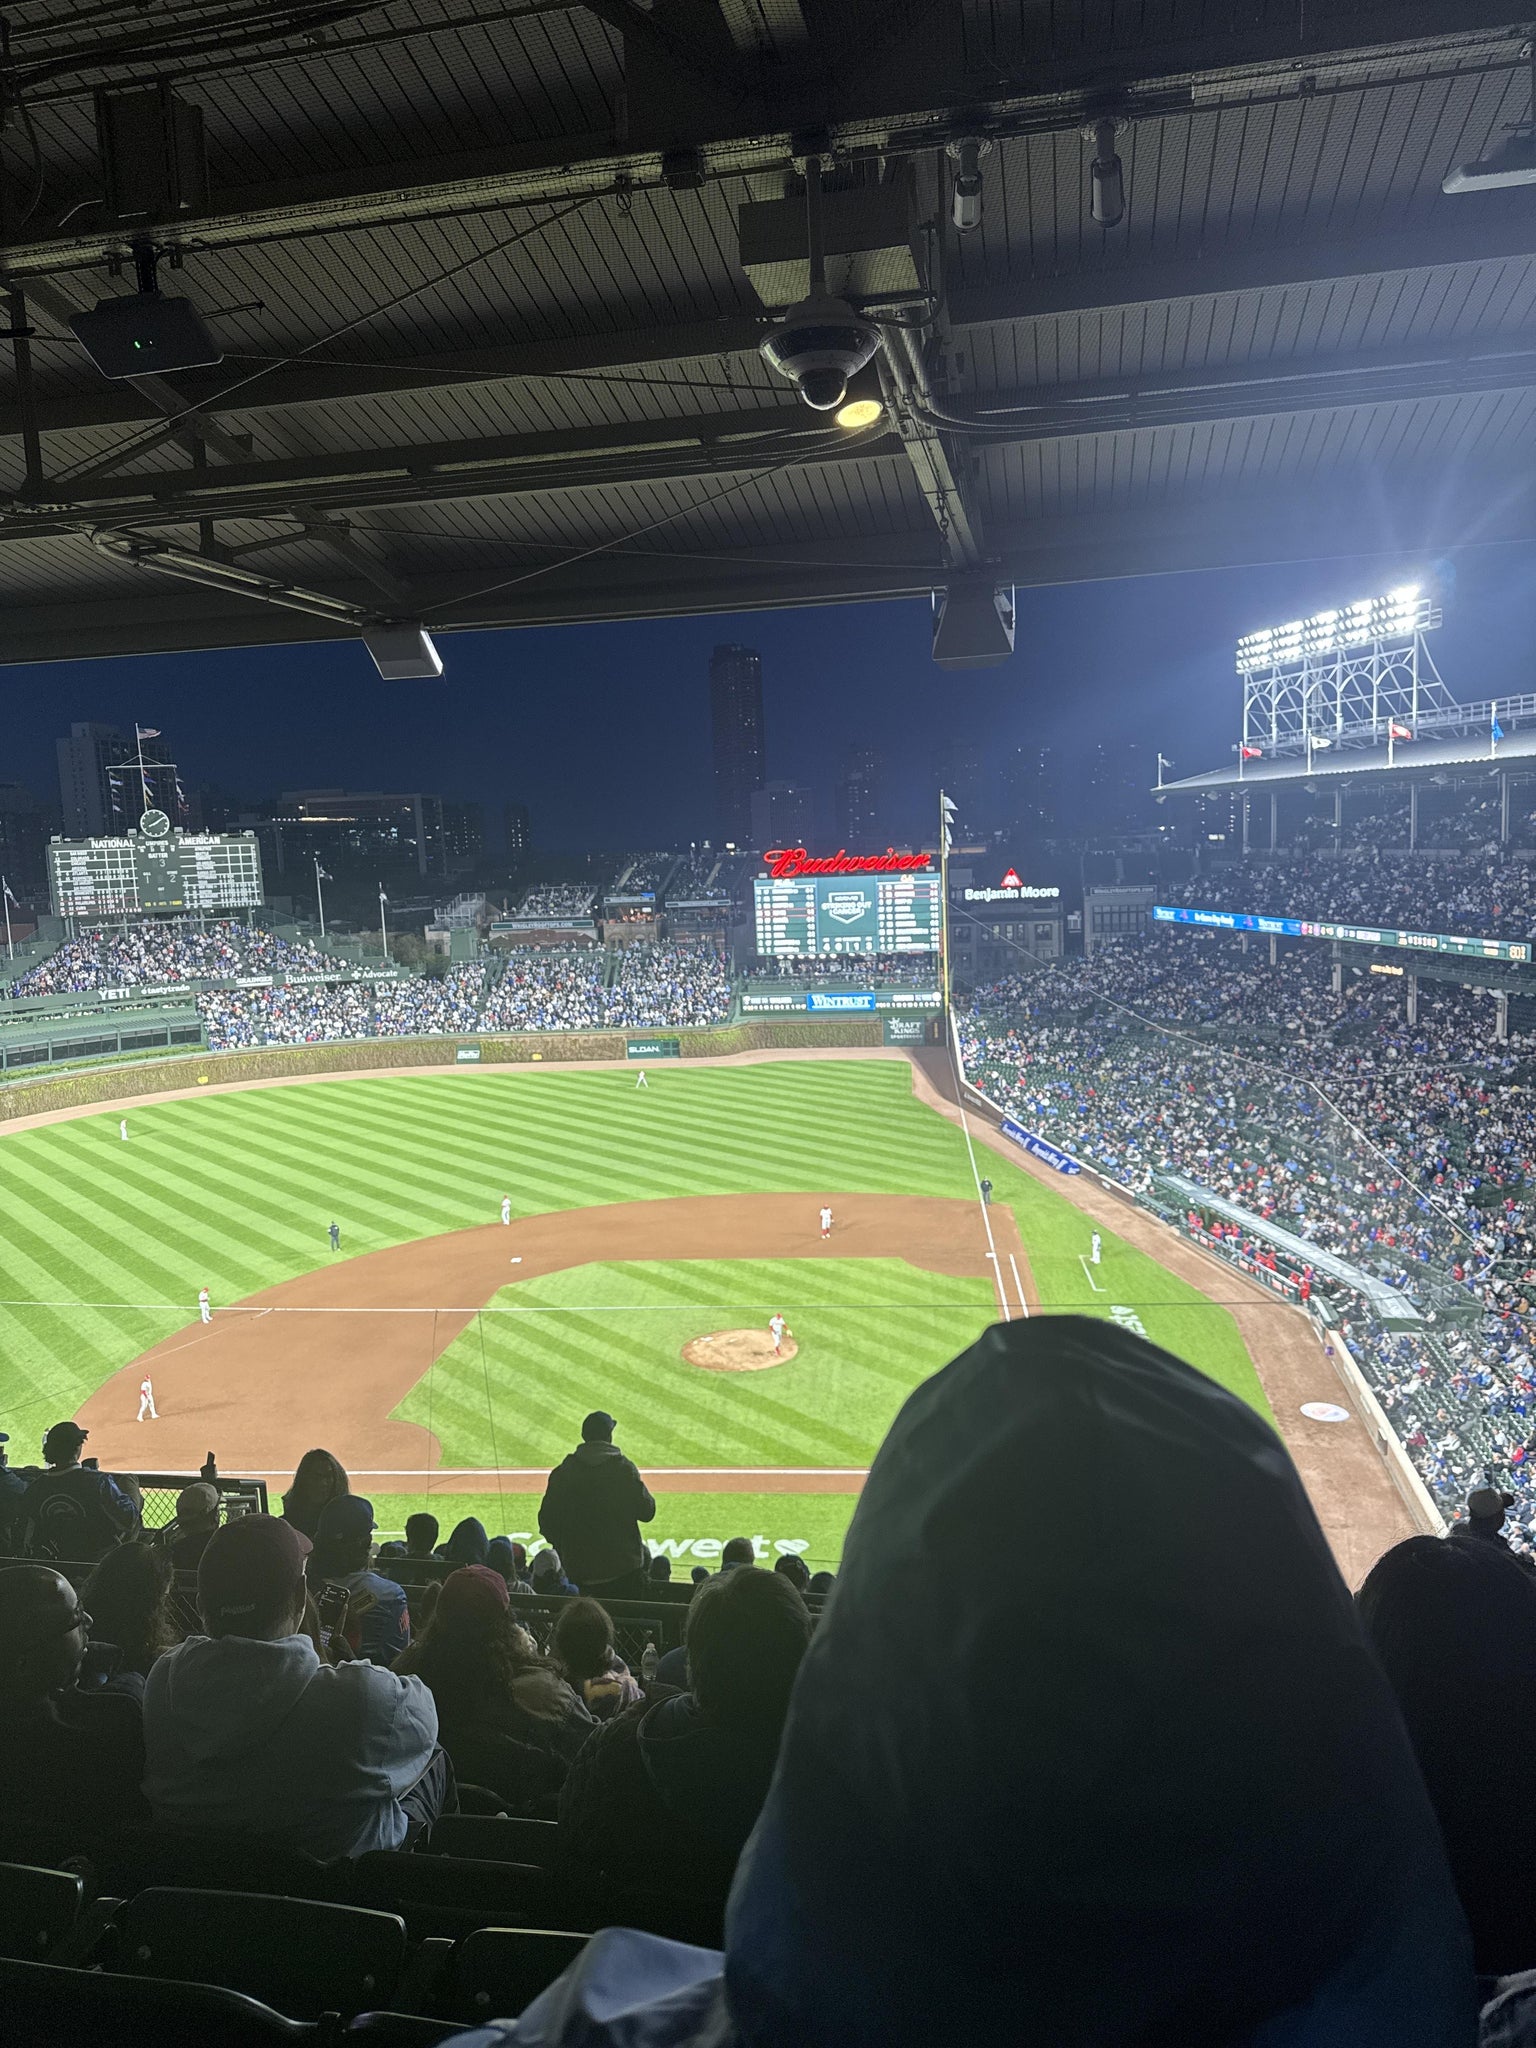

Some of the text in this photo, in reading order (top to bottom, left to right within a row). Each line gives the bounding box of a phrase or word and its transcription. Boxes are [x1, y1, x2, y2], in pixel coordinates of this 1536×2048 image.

[91, 839, 136, 849] NATIONAL
[178, 836, 221, 846] AMERICAN
[159, 859, 166, 867] 3
[764, 847, 931, 878] Budweiser
[170, 874, 176, 883] 2
[964, 886, 1060, 902] Benjamin Moore
[361, 970, 398, 979] Advocate
[236, 976, 273, 984] GRAINGER
[98, 988, 130, 1000] YETI
[890, 1021, 921, 1029] DRAFT
